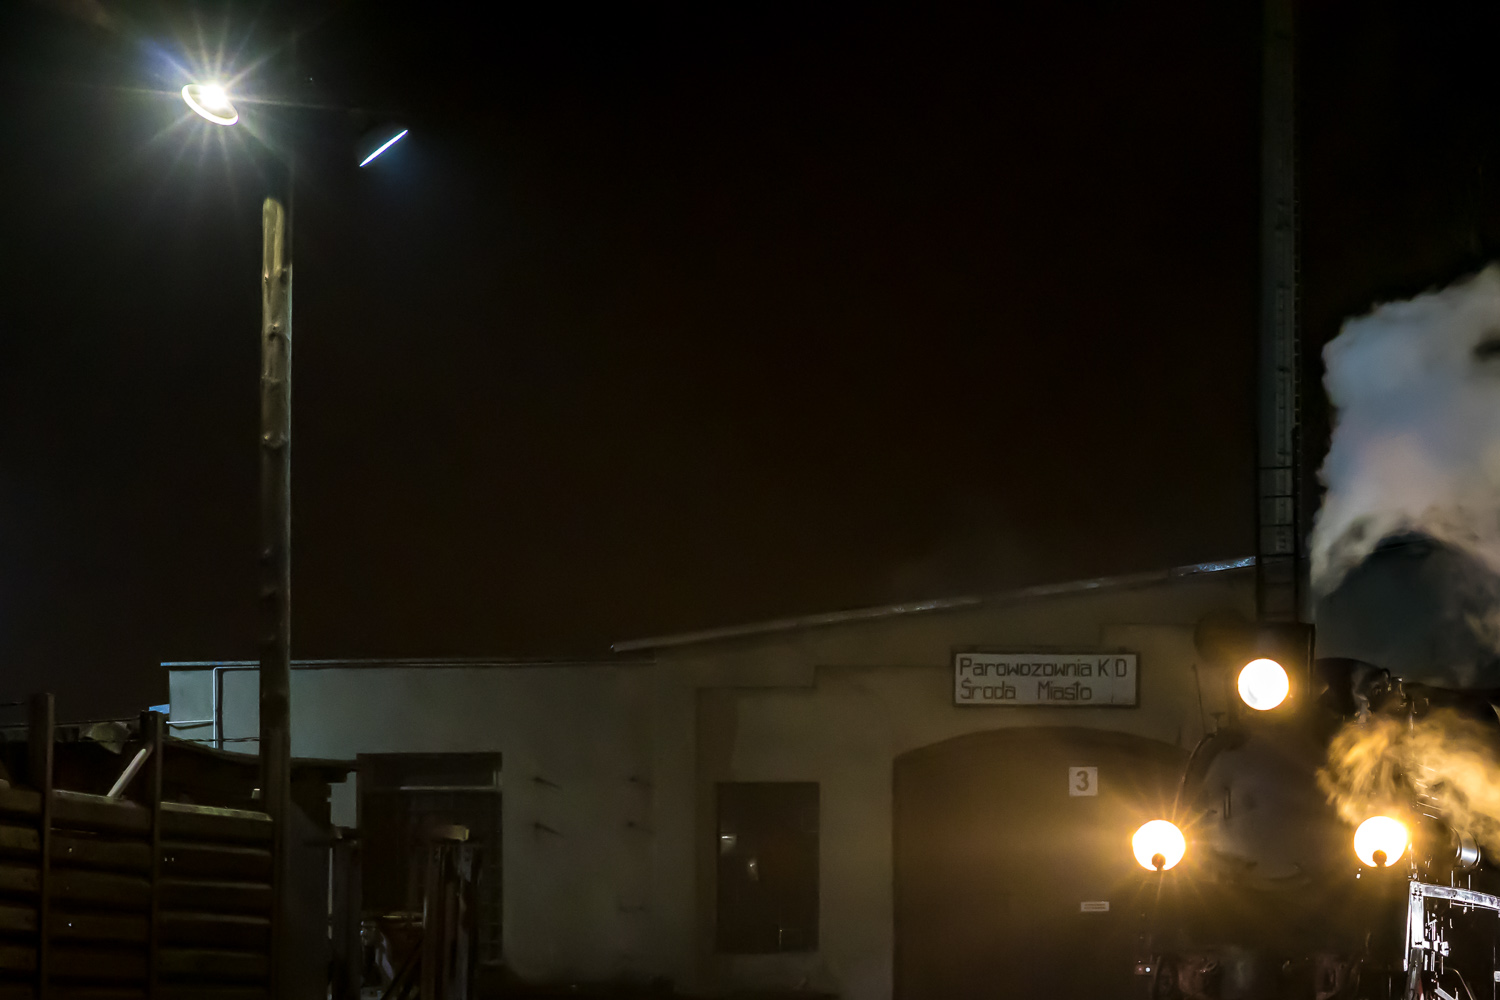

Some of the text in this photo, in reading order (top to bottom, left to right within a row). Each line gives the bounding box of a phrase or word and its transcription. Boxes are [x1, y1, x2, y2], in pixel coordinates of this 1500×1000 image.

[959, 657, 1093, 677] Parowozownia
[960, 677, 1093, 701] Środa Miasto
[1076, 770, 1089, 791] 3
